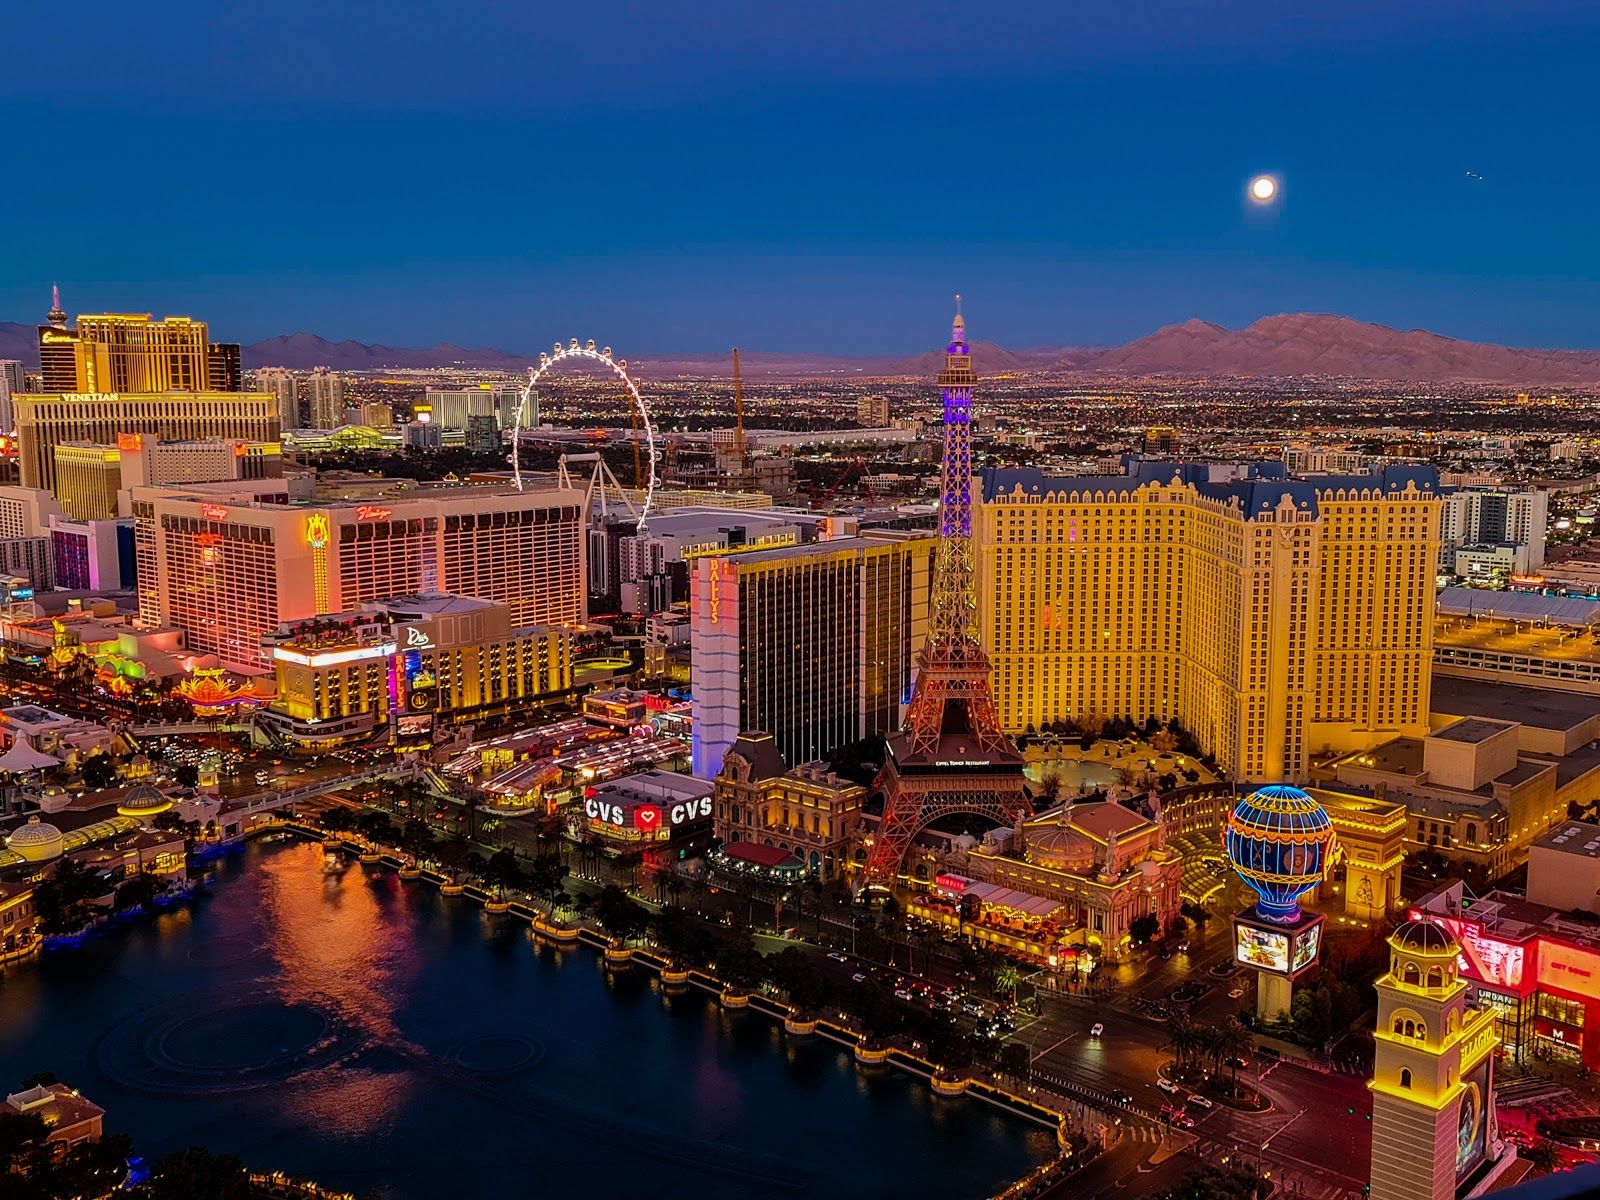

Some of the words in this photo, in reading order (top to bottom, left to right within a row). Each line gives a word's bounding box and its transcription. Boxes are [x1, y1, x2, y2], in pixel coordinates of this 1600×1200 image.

[61, 393, 118, 402] VENETIAN
[585, 798, 625, 826] CVS
[671, 796, 713, 825] CVS
[1478, 989, 1513, 1005] URBAN
[1553, 1029, 1564, 1040] M
